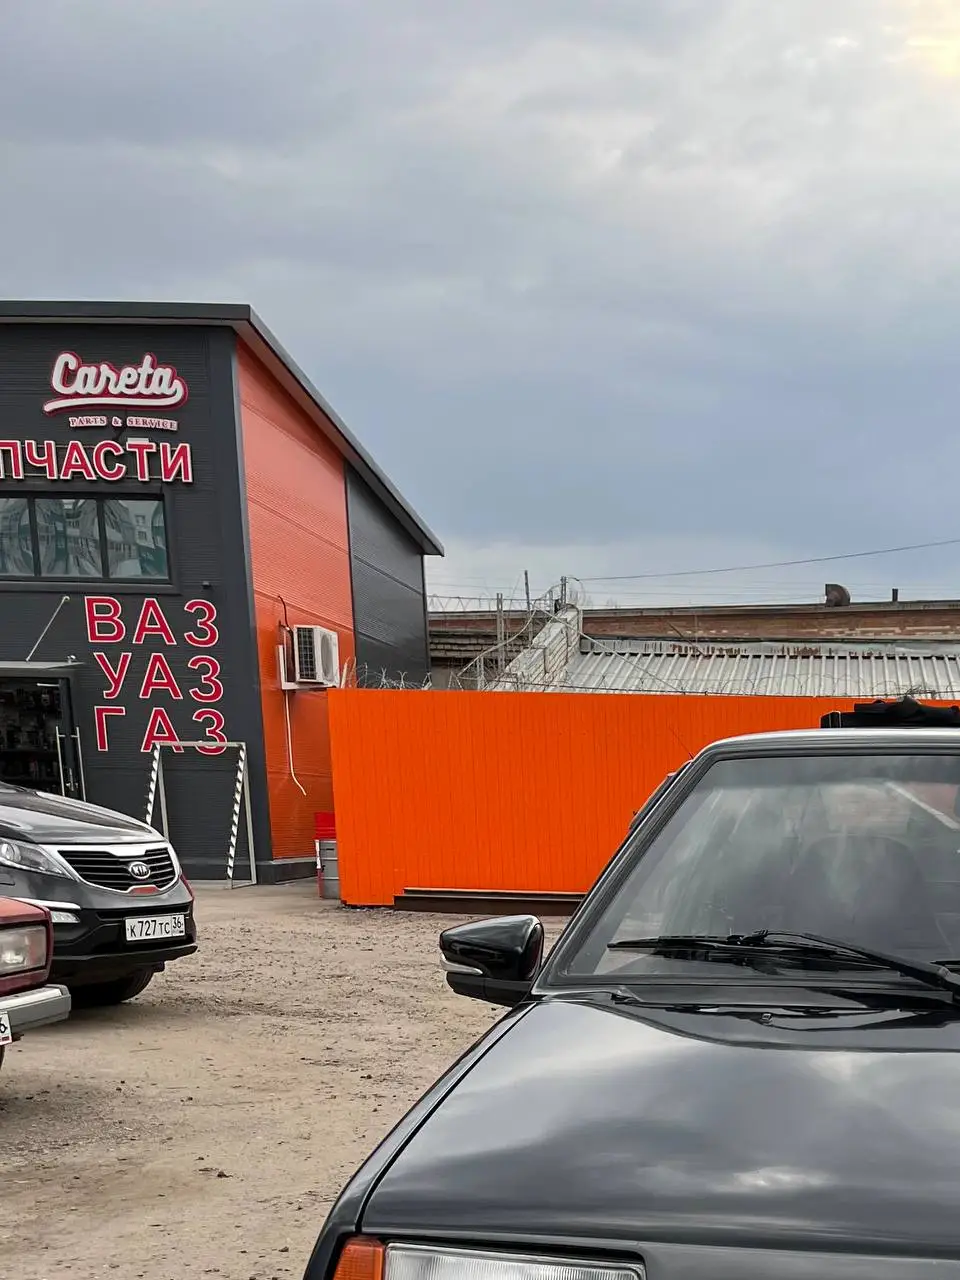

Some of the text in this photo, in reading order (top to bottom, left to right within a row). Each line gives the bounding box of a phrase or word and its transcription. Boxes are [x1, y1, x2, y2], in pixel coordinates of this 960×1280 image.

[46, 352, 187, 408] Careta
[69, 416, 178, 431] PARTS & SERVICE
[84, 595, 219, 648] ВАЗ
[93, 652, 224, 703] УАЗ
[94, 705, 228, 755] ГАЗ
[132, 865, 147, 876] KIA
